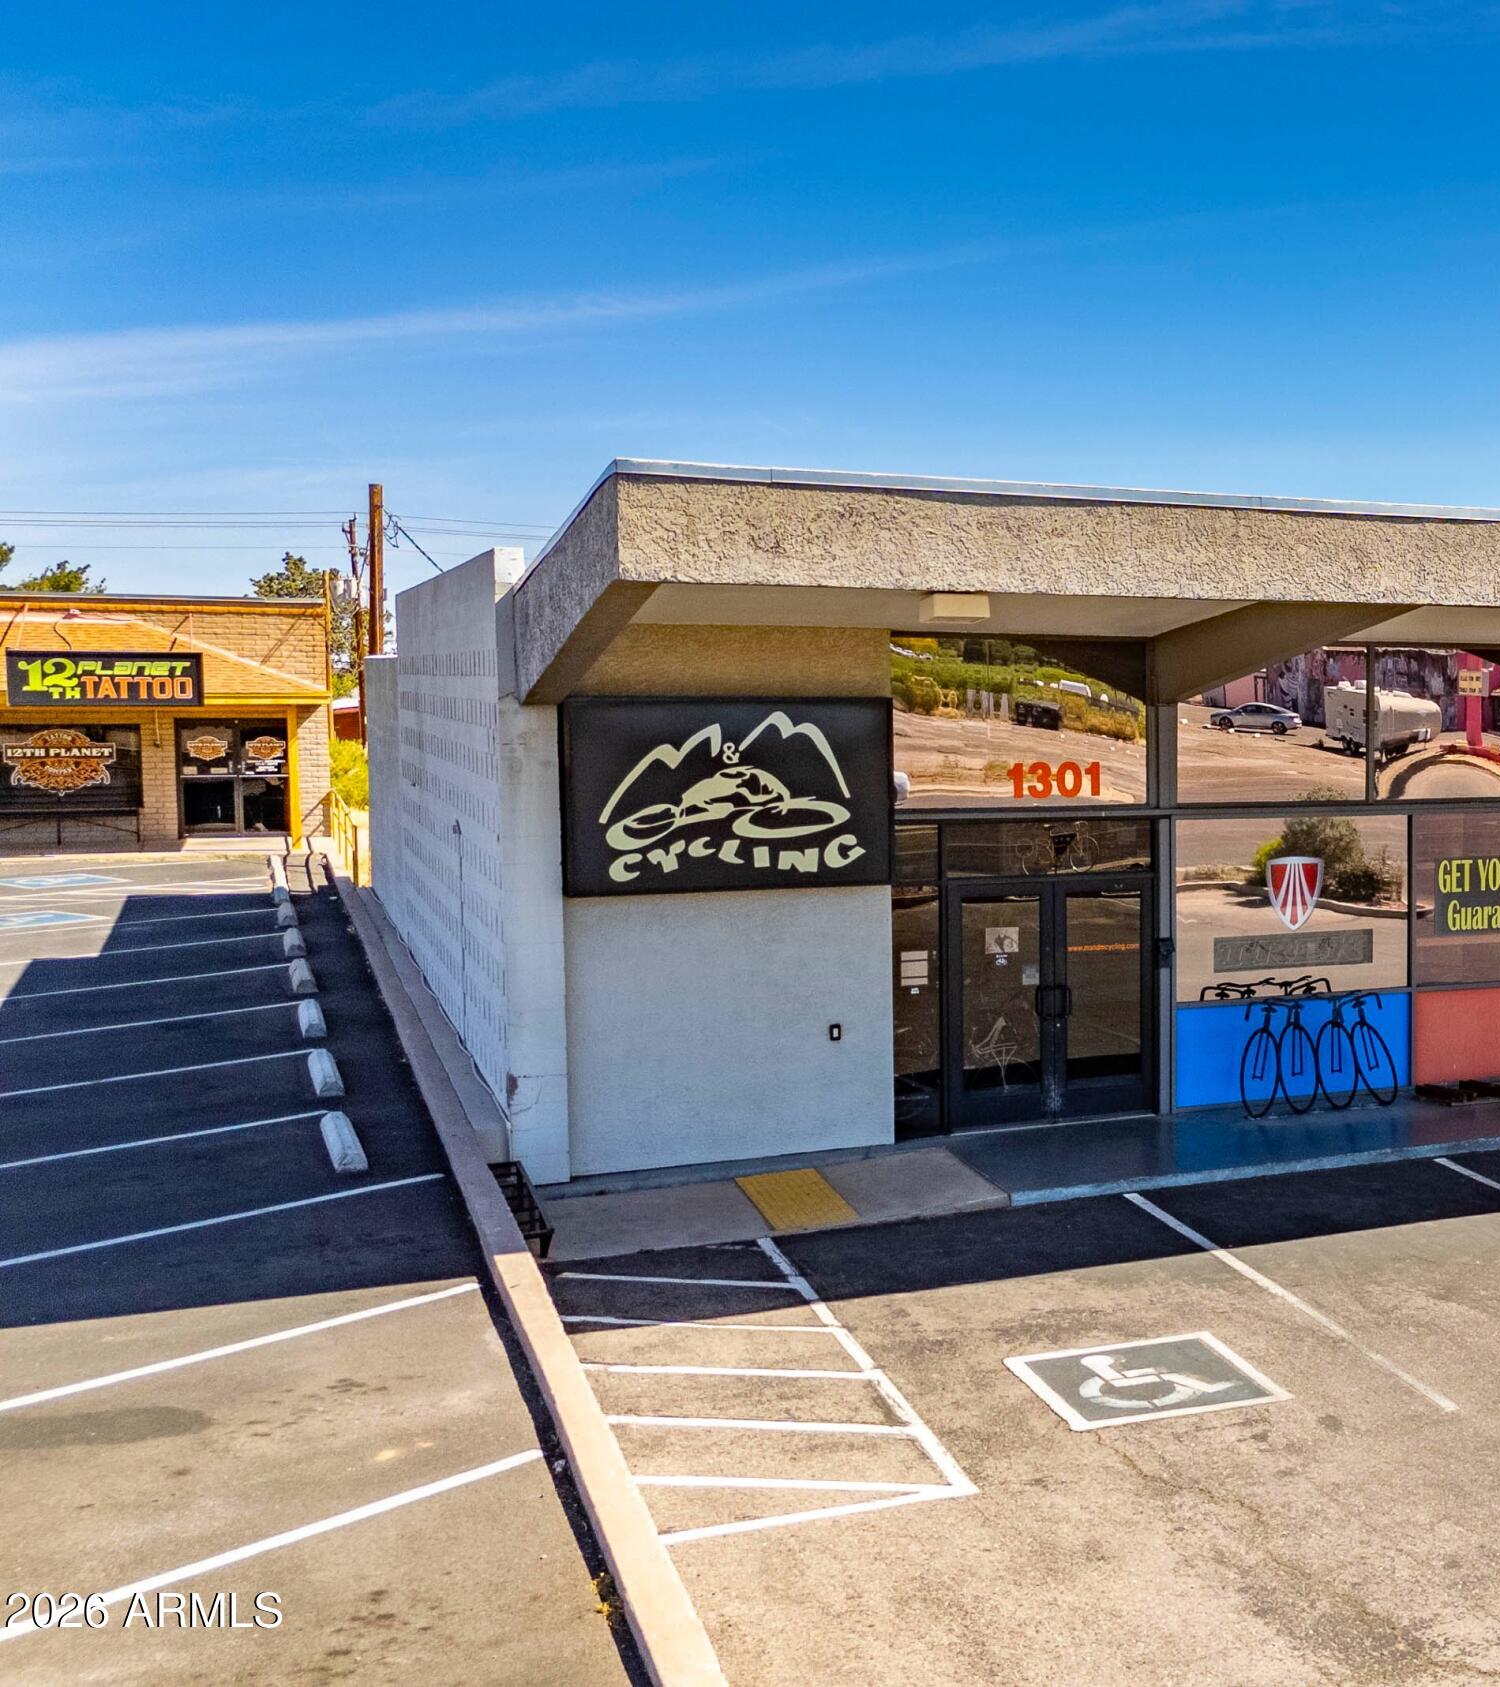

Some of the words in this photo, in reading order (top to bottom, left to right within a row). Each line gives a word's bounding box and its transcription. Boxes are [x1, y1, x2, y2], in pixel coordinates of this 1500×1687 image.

[80, 676, 193, 699] TATTOO
[6, 748, 46, 757] 12TH
[49, 748, 112, 757] PLANET
[723, 742, 740, 763] &
[1007, 761, 1101, 798] 1301
[609, 834, 866, 882] CYCLING
[1438, 859, 1473, 893] GET
